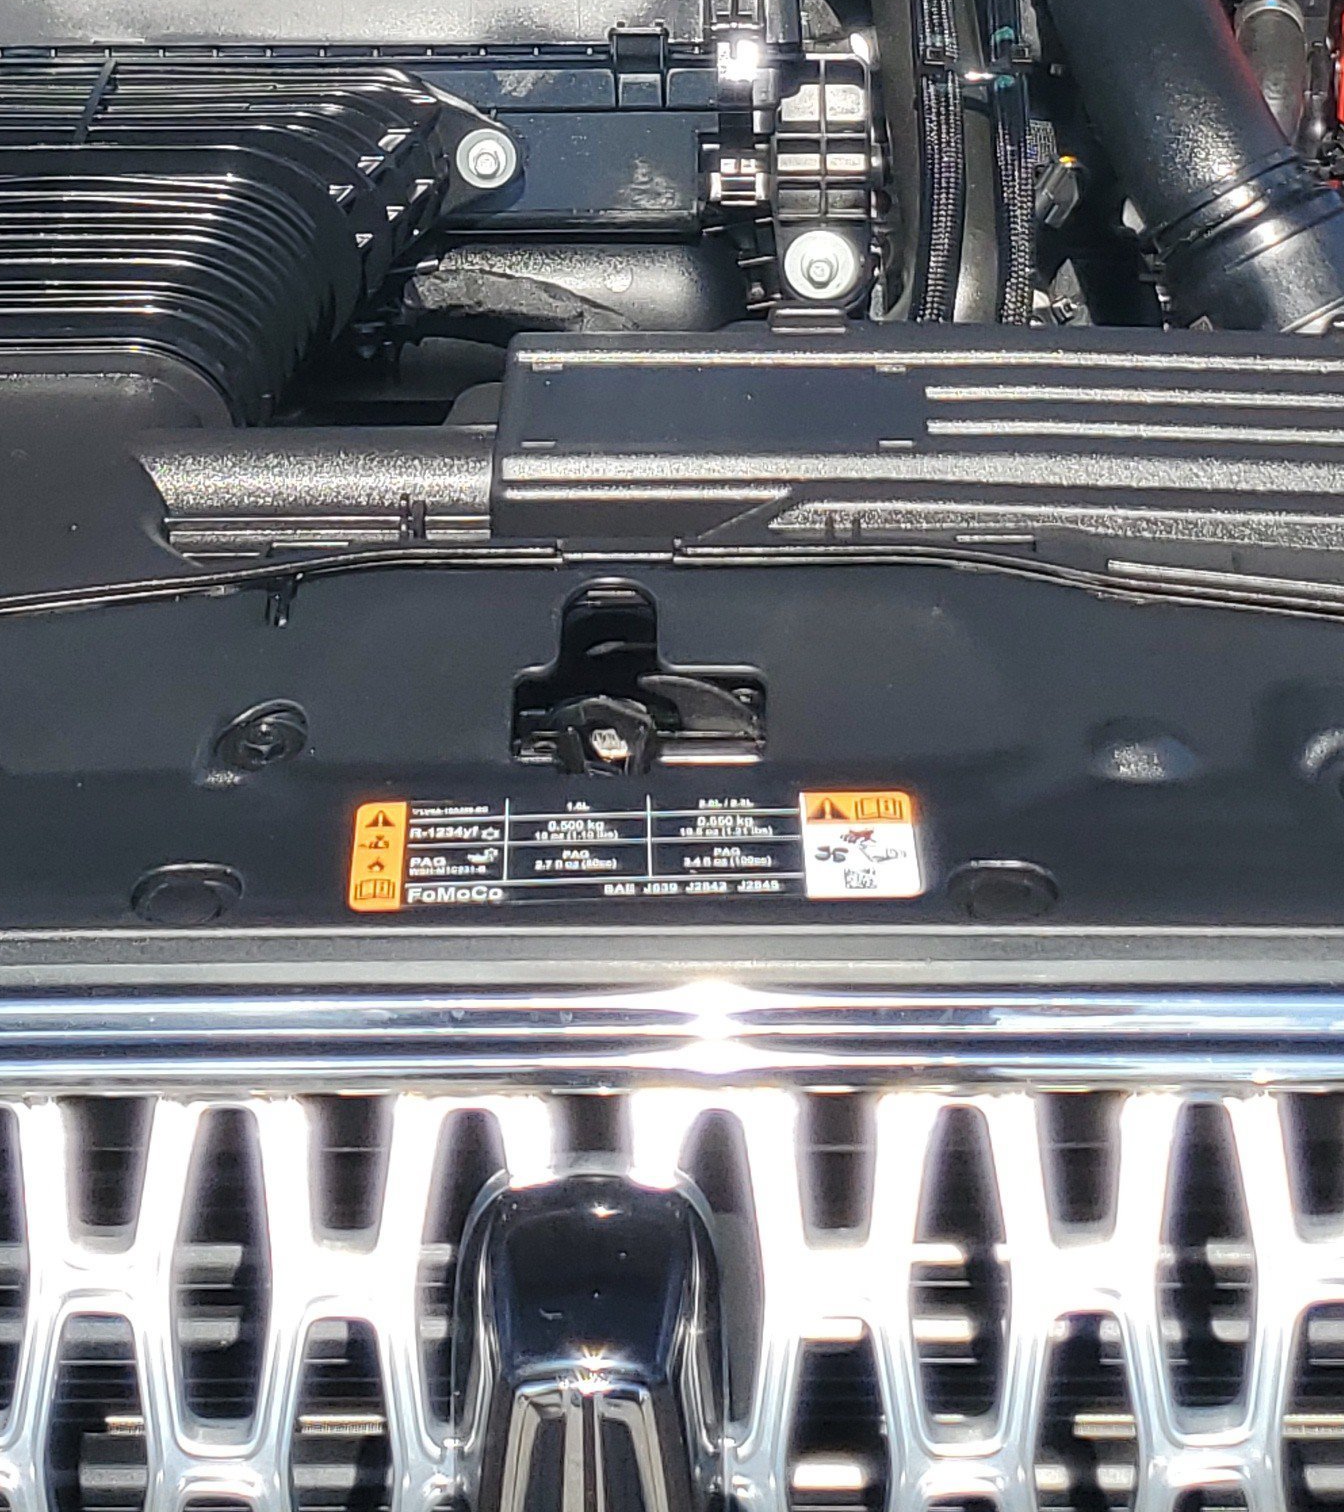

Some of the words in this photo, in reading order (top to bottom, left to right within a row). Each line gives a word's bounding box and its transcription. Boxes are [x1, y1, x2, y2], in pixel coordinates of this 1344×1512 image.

[548, 819, 584, 831] 0.500
[587, 819, 604, 832] kg
[736, 815, 754, 828] kg
[409, 826, 479, 840] R-1234yf
[410, 856, 447, 868] PAG
[407, 886, 503, 904] FoMoCo
